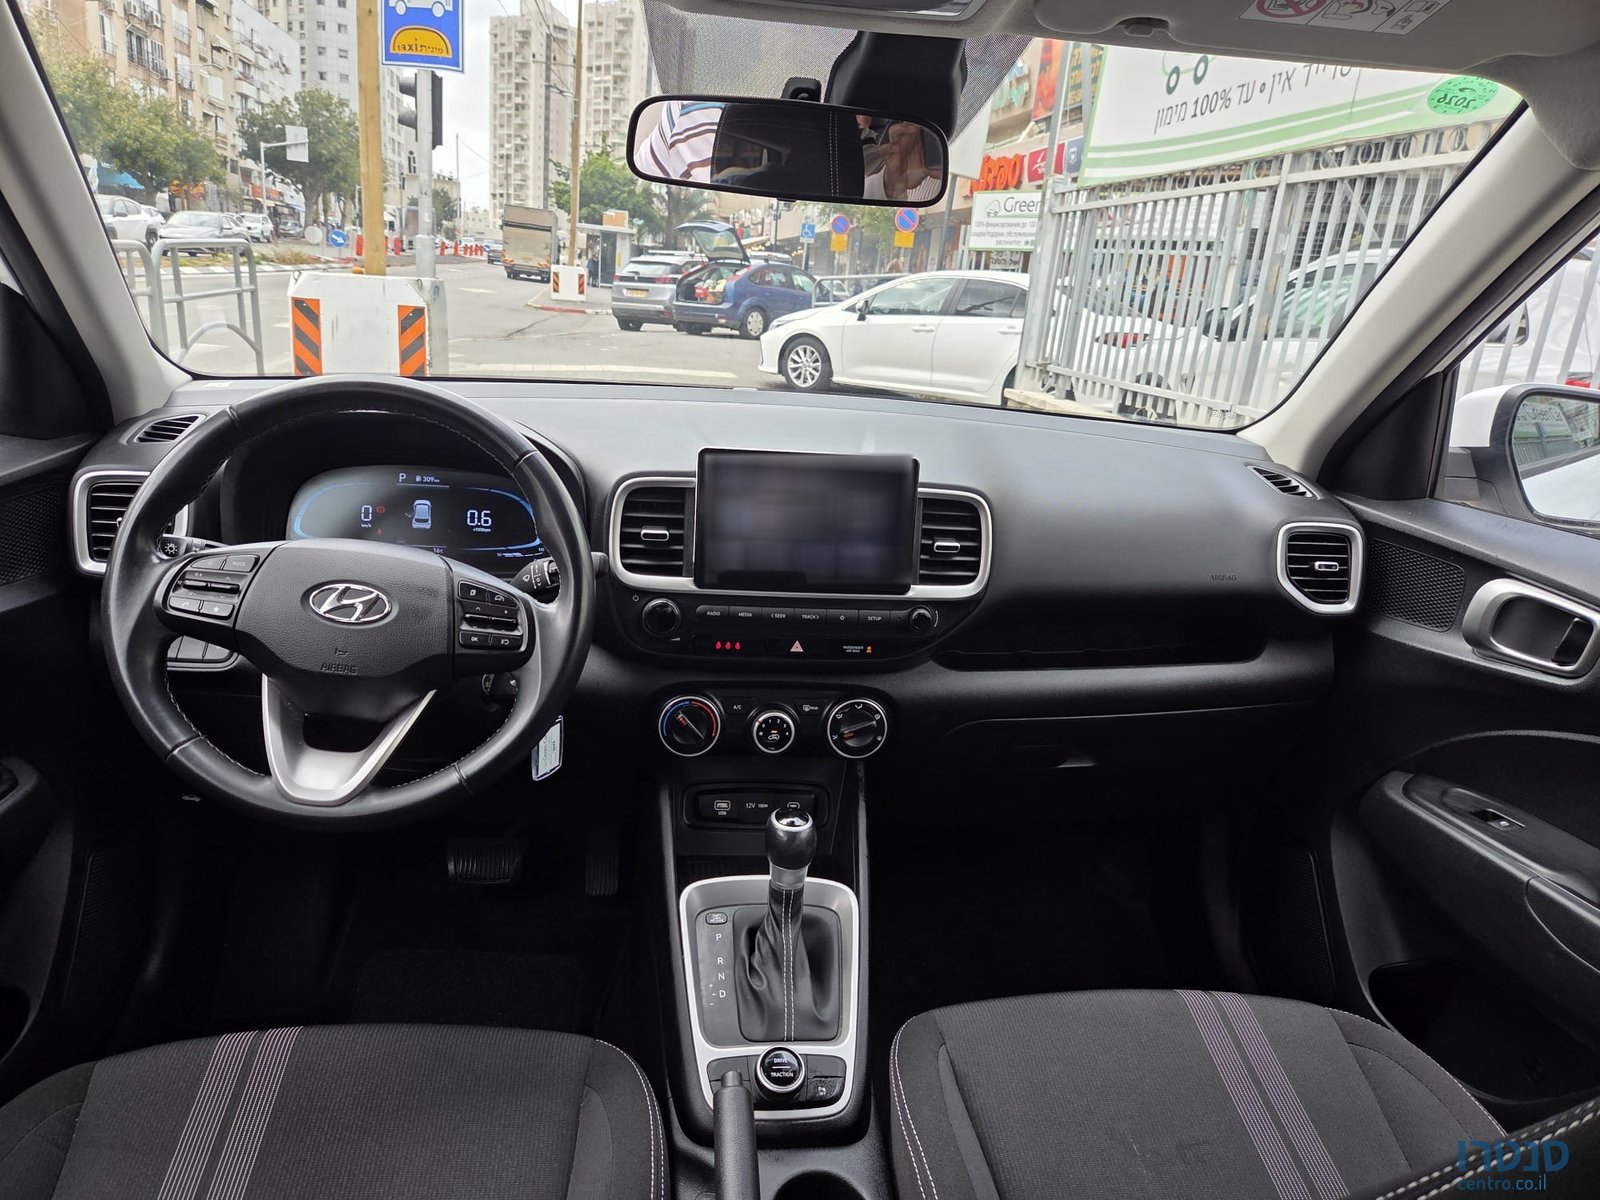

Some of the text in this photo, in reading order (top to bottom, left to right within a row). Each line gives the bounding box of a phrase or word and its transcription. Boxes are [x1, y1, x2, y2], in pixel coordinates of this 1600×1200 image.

[397, 38, 418, 52] taxi
[1236, 80, 1257, 106] עד
[1268, 68, 1296, 105] אין
[1190, 86, 1232, 119] 100%
[1154, 101, 1188, 135] מימון
[398, 473, 407, 483] P
[361, 505, 372, 521] 0
[466, 509, 492, 527] 0.6
[320, 661, 358, 675] AIRBAG
[715, 933, 722, 941] P
[717, 957, 724, 965] R
[718, 972, 725, 981] N
[719, 989, 726, 998] D
